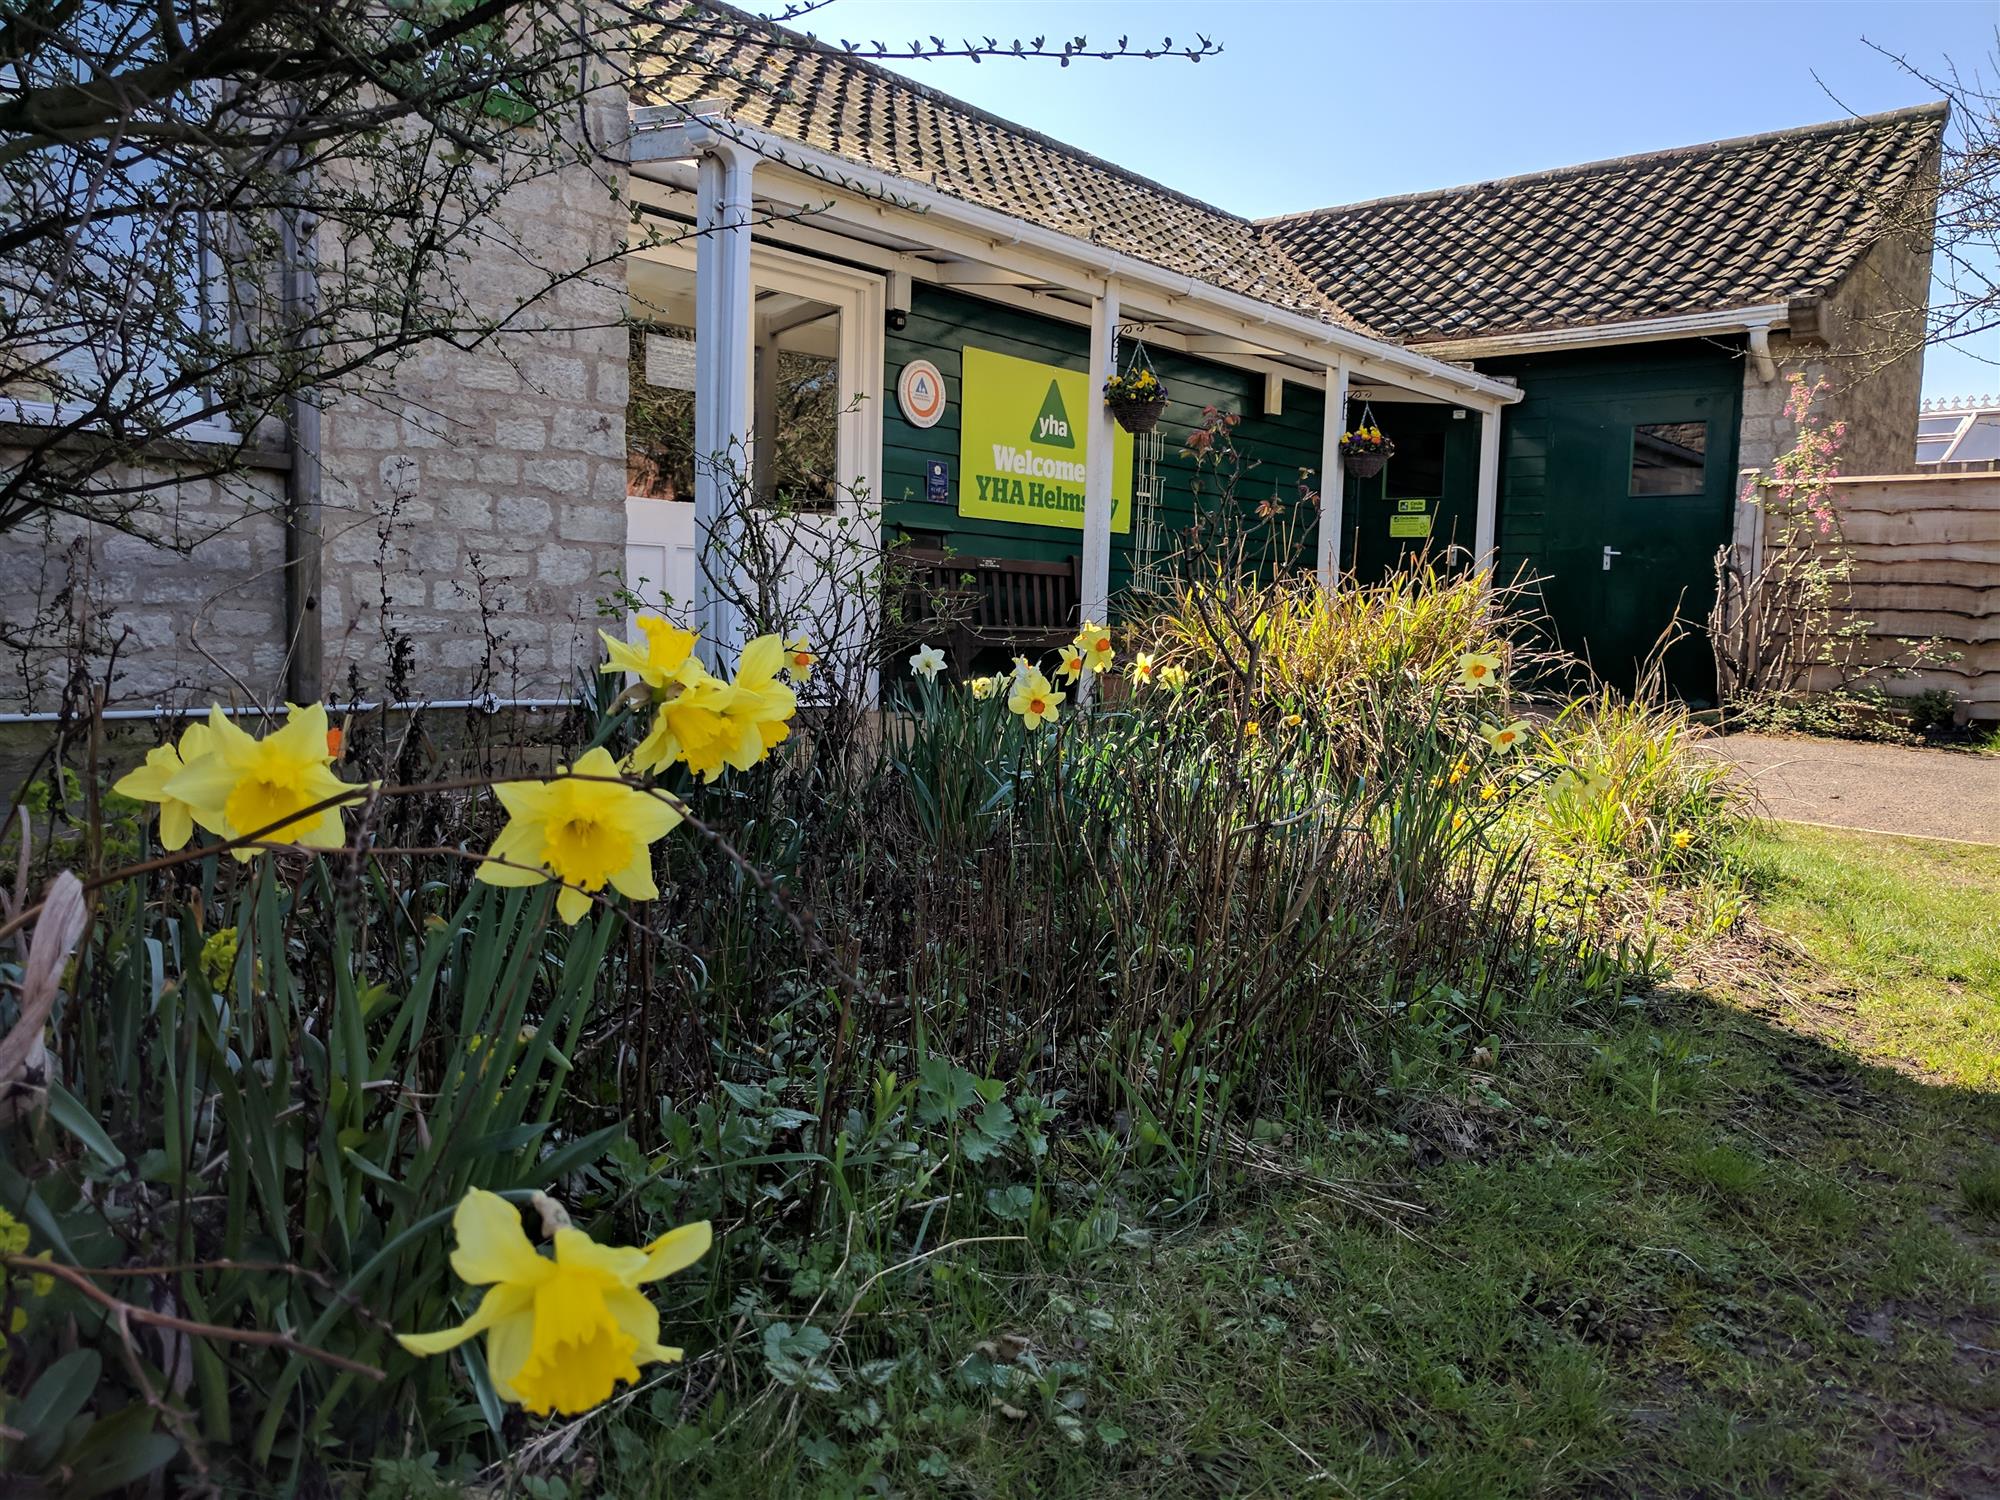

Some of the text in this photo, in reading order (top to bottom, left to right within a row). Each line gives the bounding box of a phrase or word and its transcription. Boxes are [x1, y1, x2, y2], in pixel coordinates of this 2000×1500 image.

[1039, 414, 1068, 438] yha
[992, 444, 1086, 482] Welcome
[976, 475, 1025, 505] YHA
